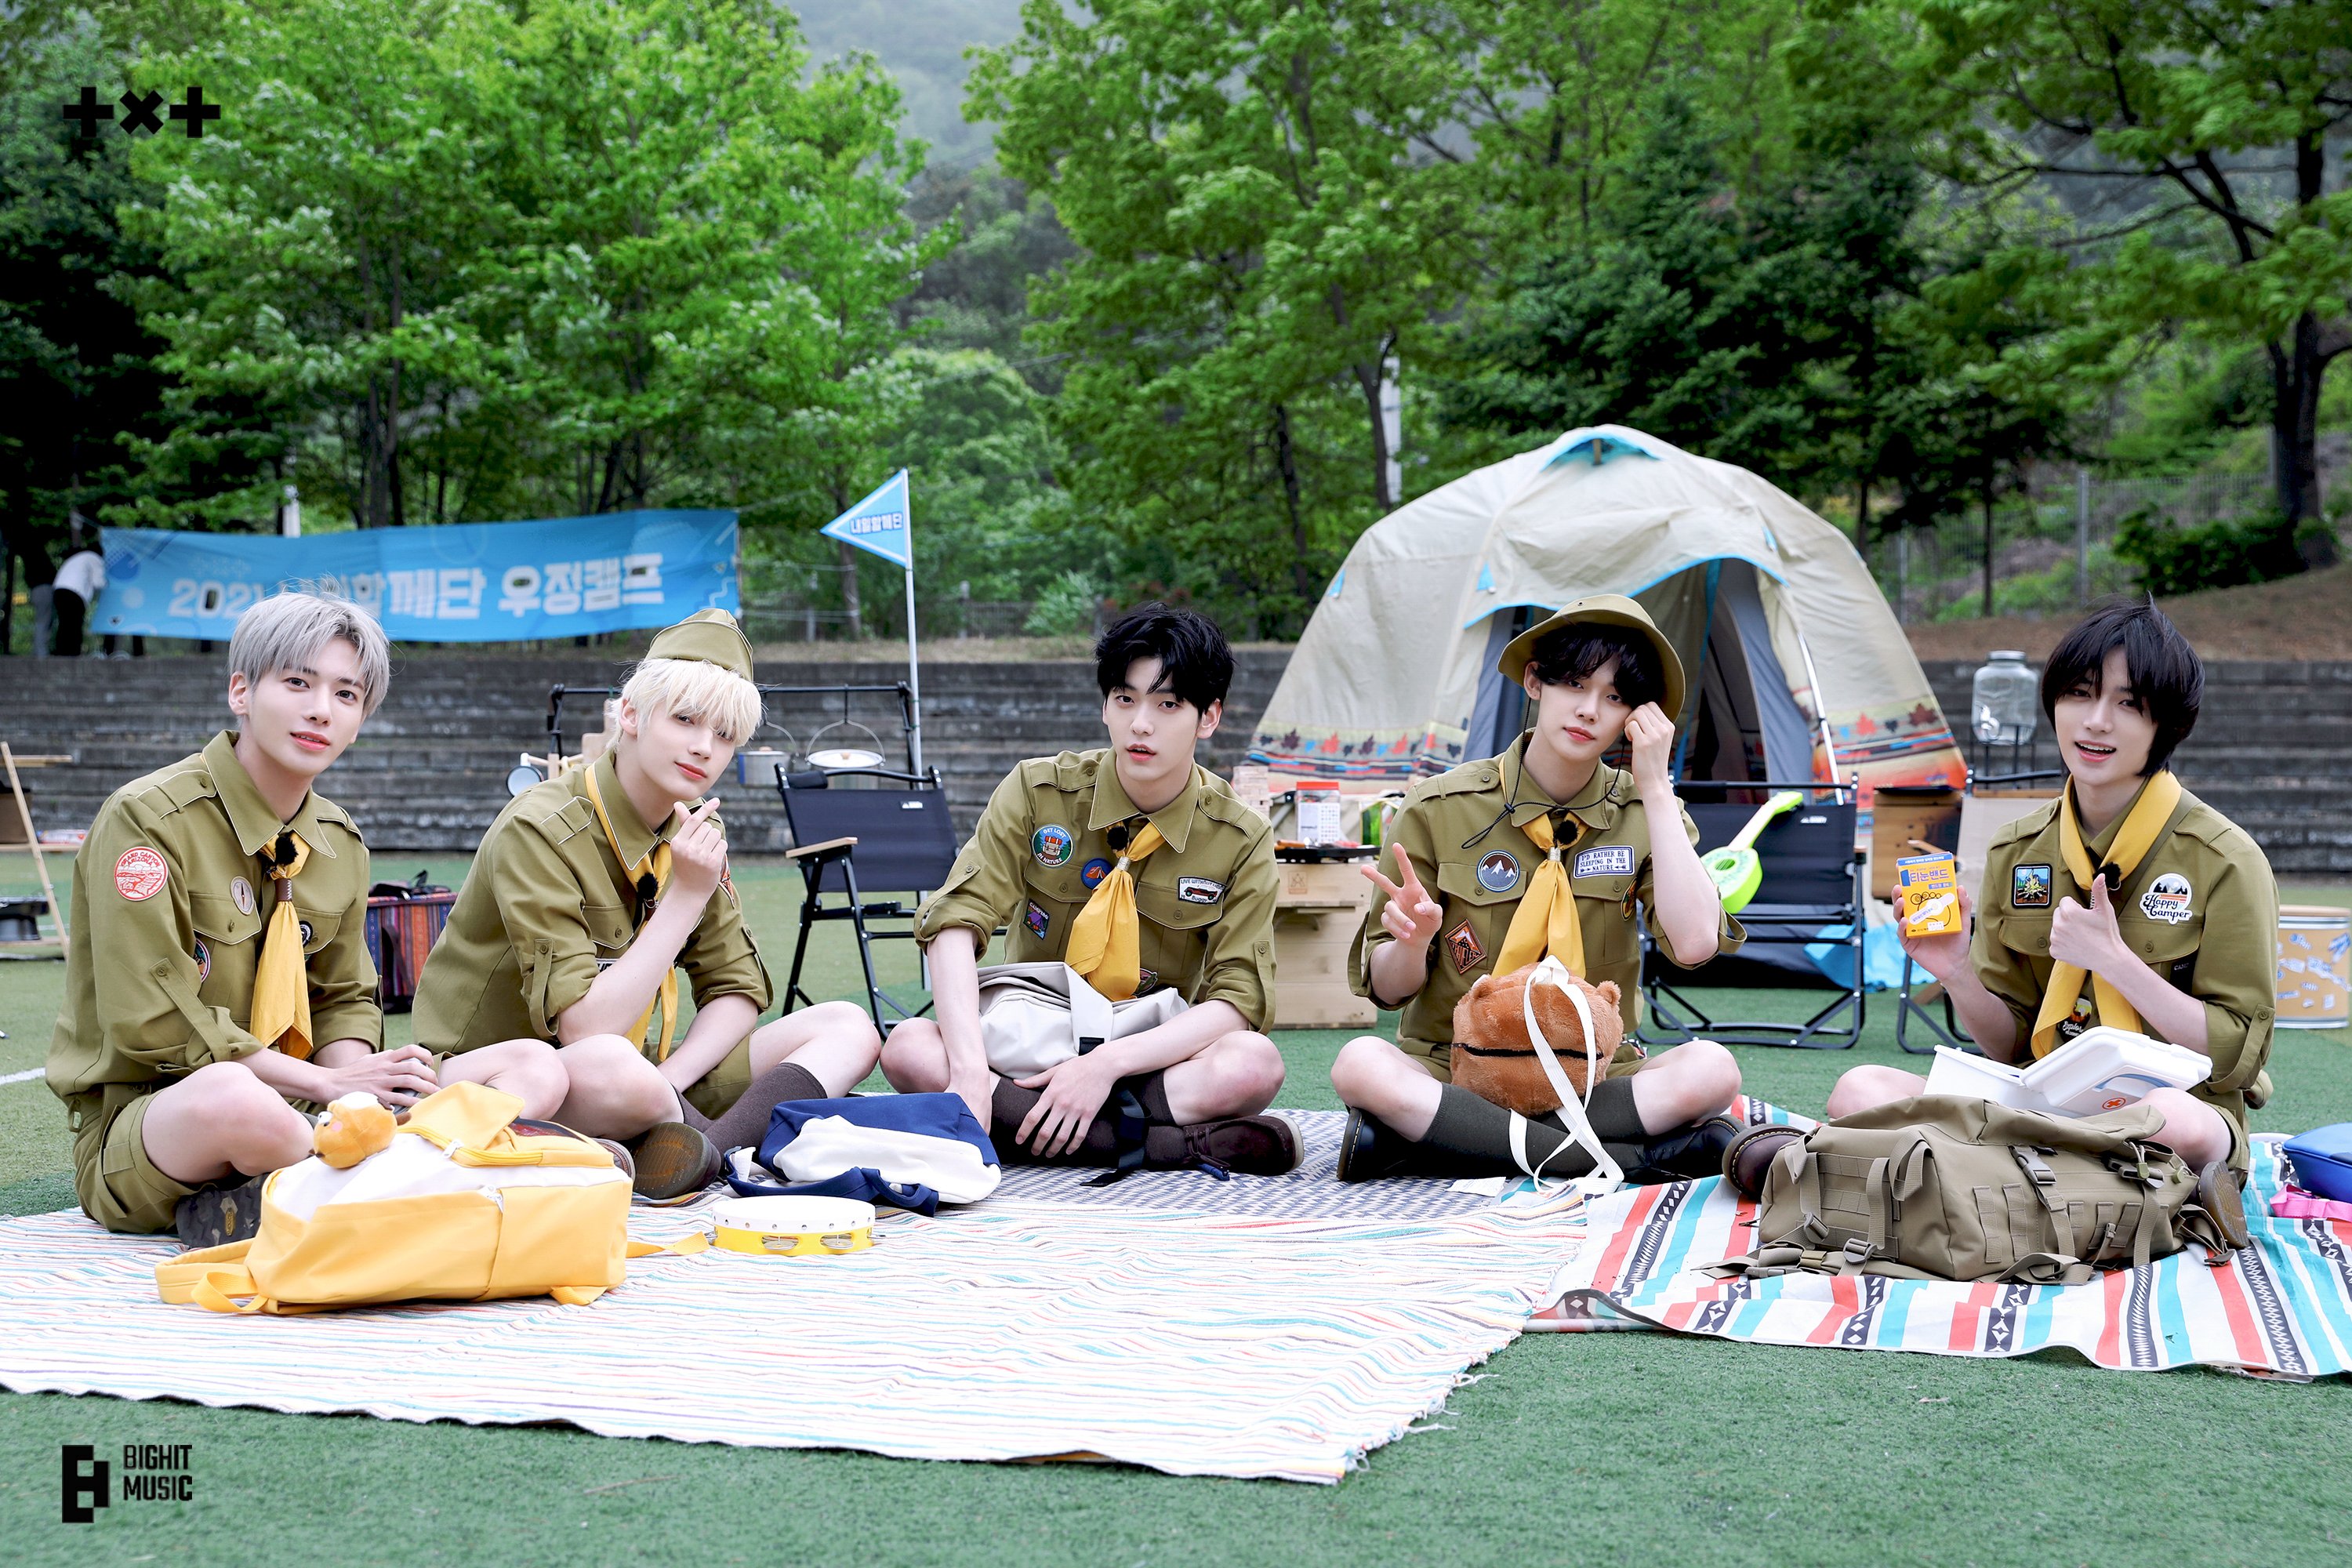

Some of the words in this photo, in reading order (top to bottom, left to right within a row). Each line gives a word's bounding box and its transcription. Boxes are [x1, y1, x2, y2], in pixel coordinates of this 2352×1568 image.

[498, 553, 664, 618] 우정캠프
[1054, 828, 1066, 838] LOST
[121, 851, 139, 866] GRAND
[140, 851, 162, 867] CANYON
[127, 856, 154, 867] ARIZONA
[1580, 858, 1603, 867] SLEEPING
[2143, 895, 2178, 909] Happy
[2147, 905, 2190, 921] Camper
